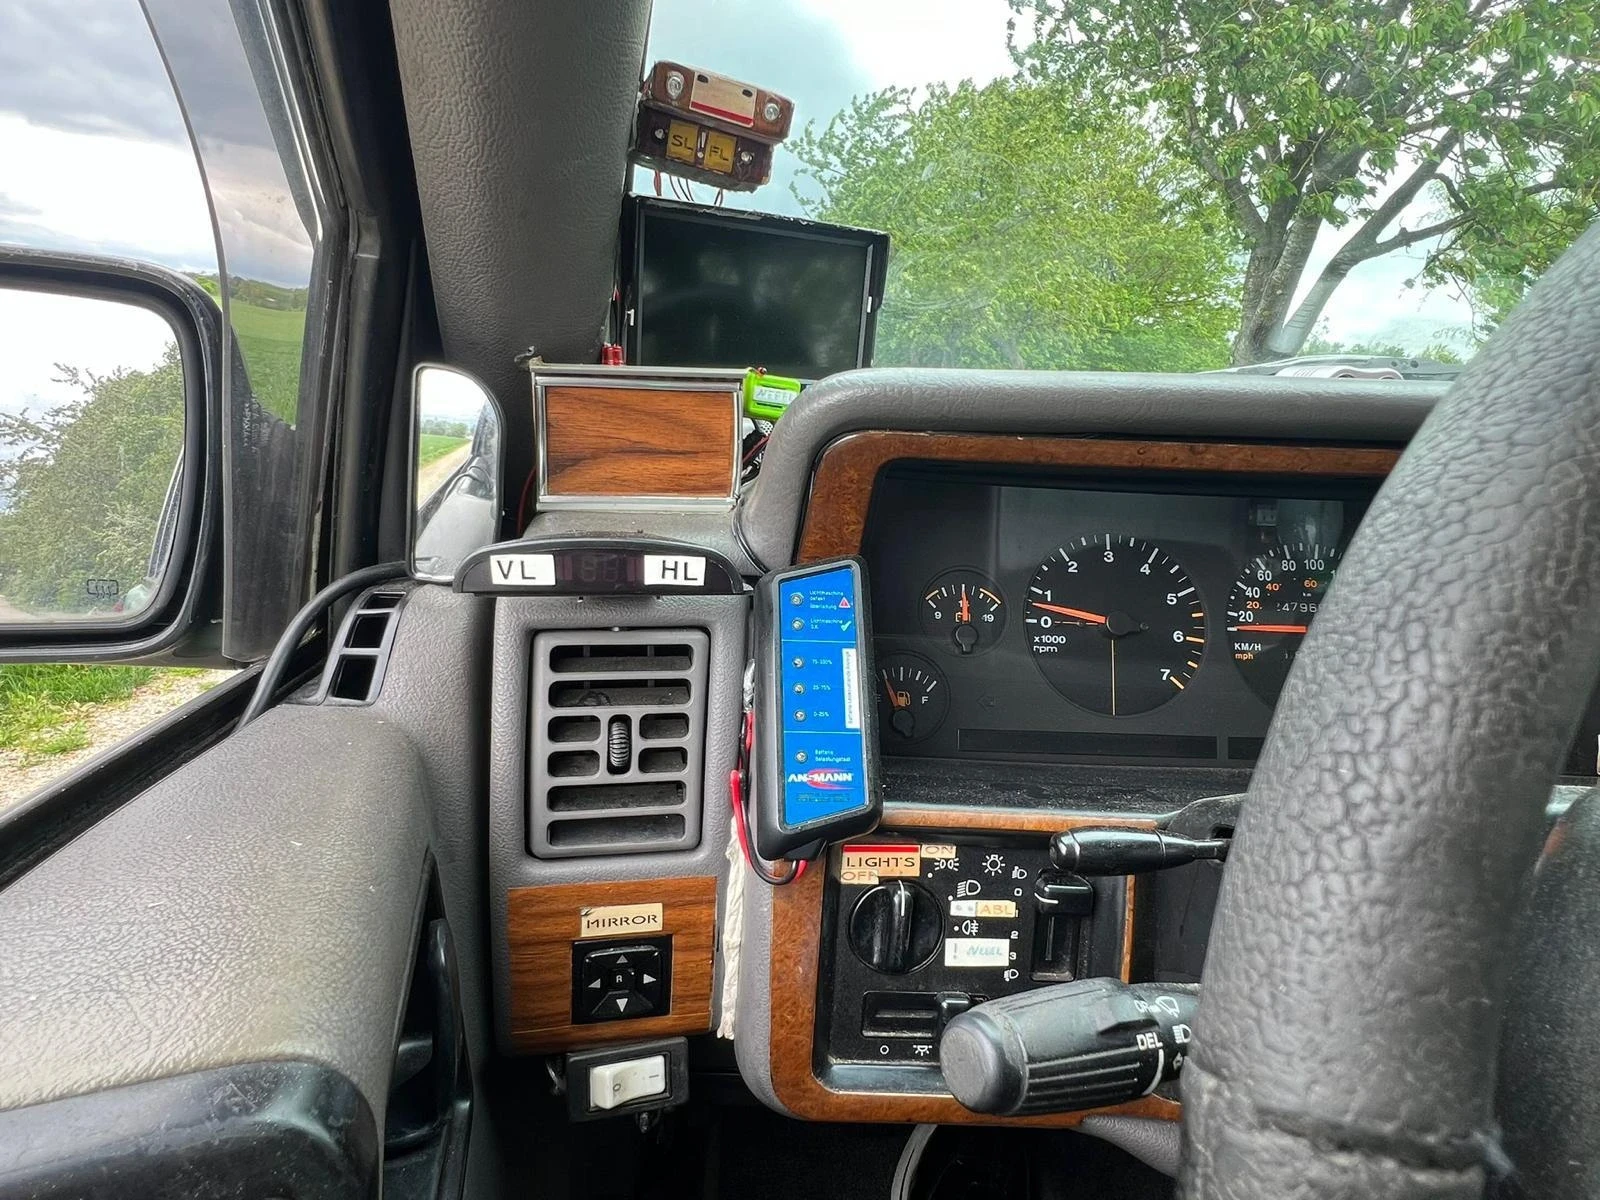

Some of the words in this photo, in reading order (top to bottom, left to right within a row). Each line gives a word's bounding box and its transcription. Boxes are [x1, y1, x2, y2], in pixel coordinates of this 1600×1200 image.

[671, 134, 694, 152] SL
[709, 145, 730, 162] FL
[1103, 551, 1114, 563] 3
[497, 560, 537, 580] VL
[661, 560, 698, 581] HL
[1068, 561, 1078, 573] 2
[1140, 563, 1151, 575] 4
[1281, 560, 1297, 571] 80
[1303, 559, 1325, 571] 100
[1257, 570, 1272, 582] 60
[1265, 583, 1280, 591] 40
[1304, 579, 1318, 588] 60
[1044, 590, 1052, 602] 1
[1245, 587, 1261, 598] 40
[1166, 593, 1177, 605] 5
[1246, 601, 1260, 609] 20
[934, 611, 942, 620] 9
[982, 613, 995, 622] 19
[1238, 611, 1254, 622] 20
[1040, 616, 1052, 628] 0
[1173, 631, 1184, 642] 6
[1234, 642, 1262, 651] KM/H
[1235, 652, 1254, 660] mph
[1160, 668, 1171, 680] 7
[921, 696, 929, 704] F
[925, 846, 954, 854] ON
[846, 857, 915, 868] LIGHTS
[841, 871, 878, 881] OFF
[586, 914, 658, 929] MIRROR
[1010, 930, 1019, 939] 2
[1009, 951, 1017, 960] 3
[616, 974, 623, 983] R
[1136, 1032, 1163, 1050] DEL
